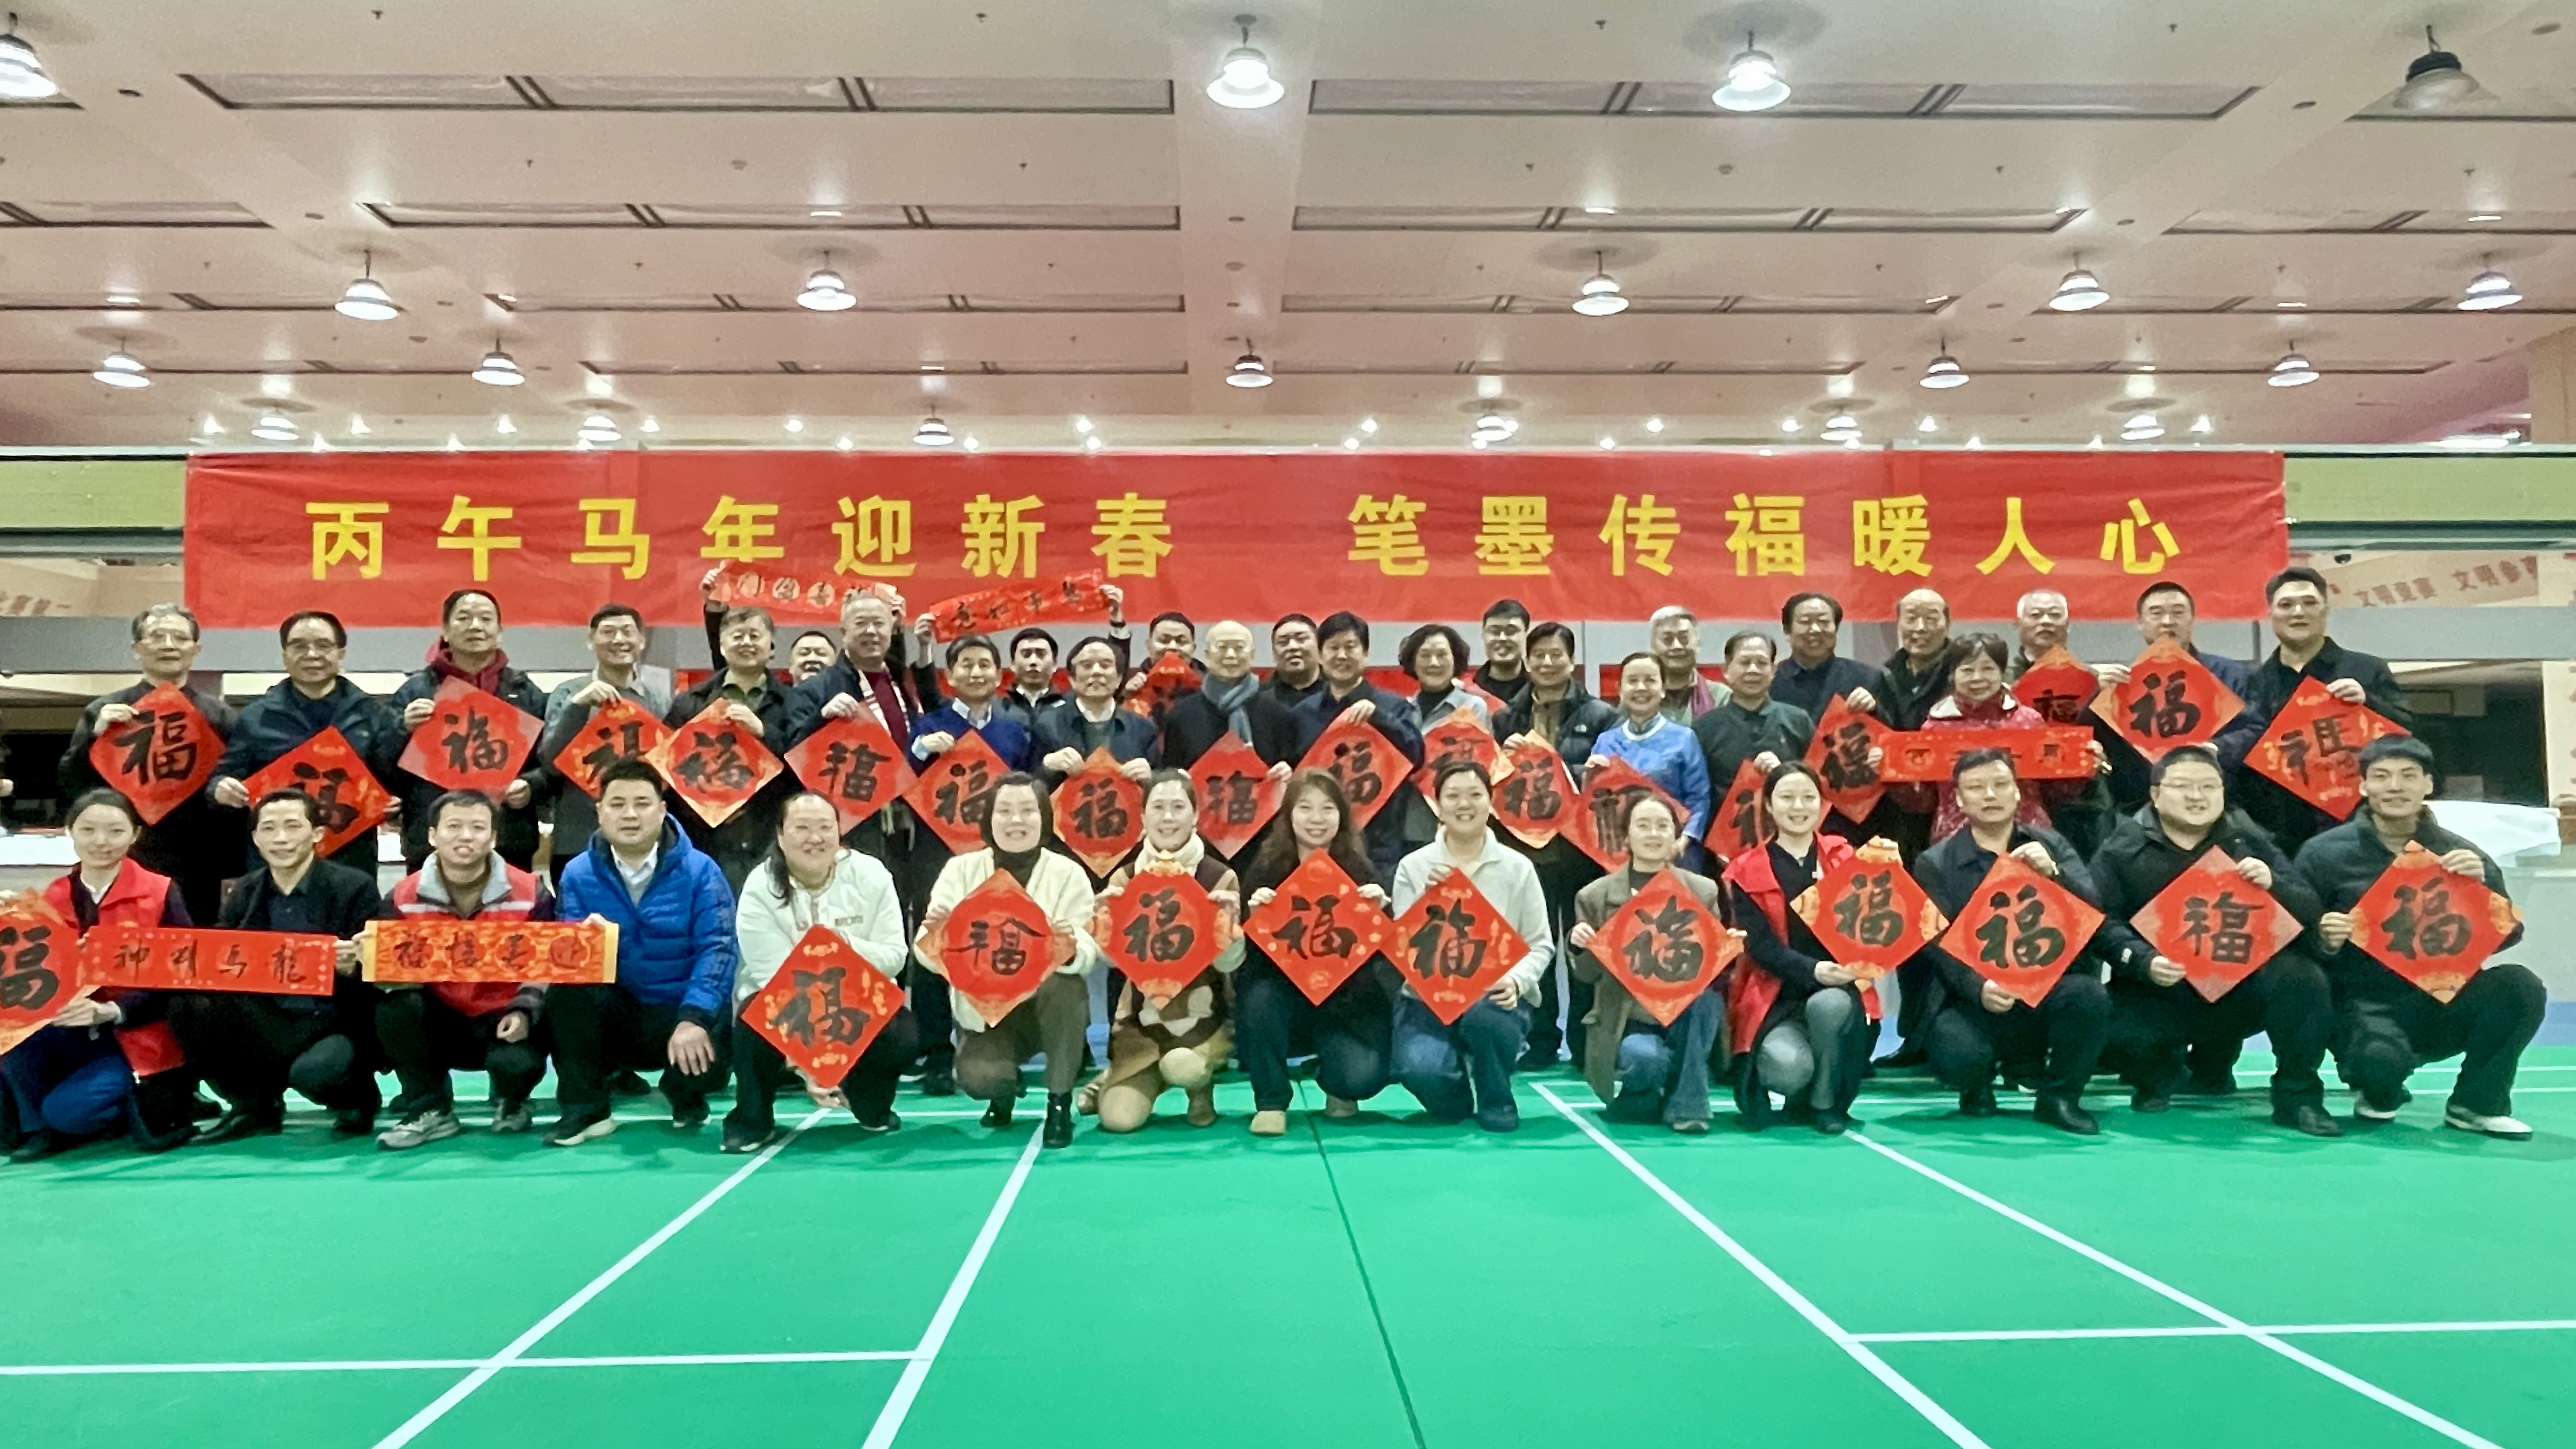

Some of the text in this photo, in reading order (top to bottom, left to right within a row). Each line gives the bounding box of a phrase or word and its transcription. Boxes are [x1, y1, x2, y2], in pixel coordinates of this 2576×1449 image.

[307, 493, 2179, 580] 丙午马年迎新春 笔墨传福暖人心
[441, 706, 509, 774] 福
[2129, 671, 2200, 737] 福
[113, 709, 198, 784] 福
[675, 731, 755, 793] 福
[1069, 777, 1128, 839] 福
[1503, 755, 1562, 820] 福
[1122, 886, 1196, 962] 福
[1271, 893, 1358, 960] 福
[1408, 898, 1488, 980] 福
[1621, 896, 1705, 982] 福
[1833, 871, 1904, 946] 福
[1975, 884, 2066, 968] 福
[2179, 891, 2265, 965] 福
[2380, 877, 2473, 959] 福
[945, 917, 1048, 976] 福
[772, 966, 871, 1047] 福
